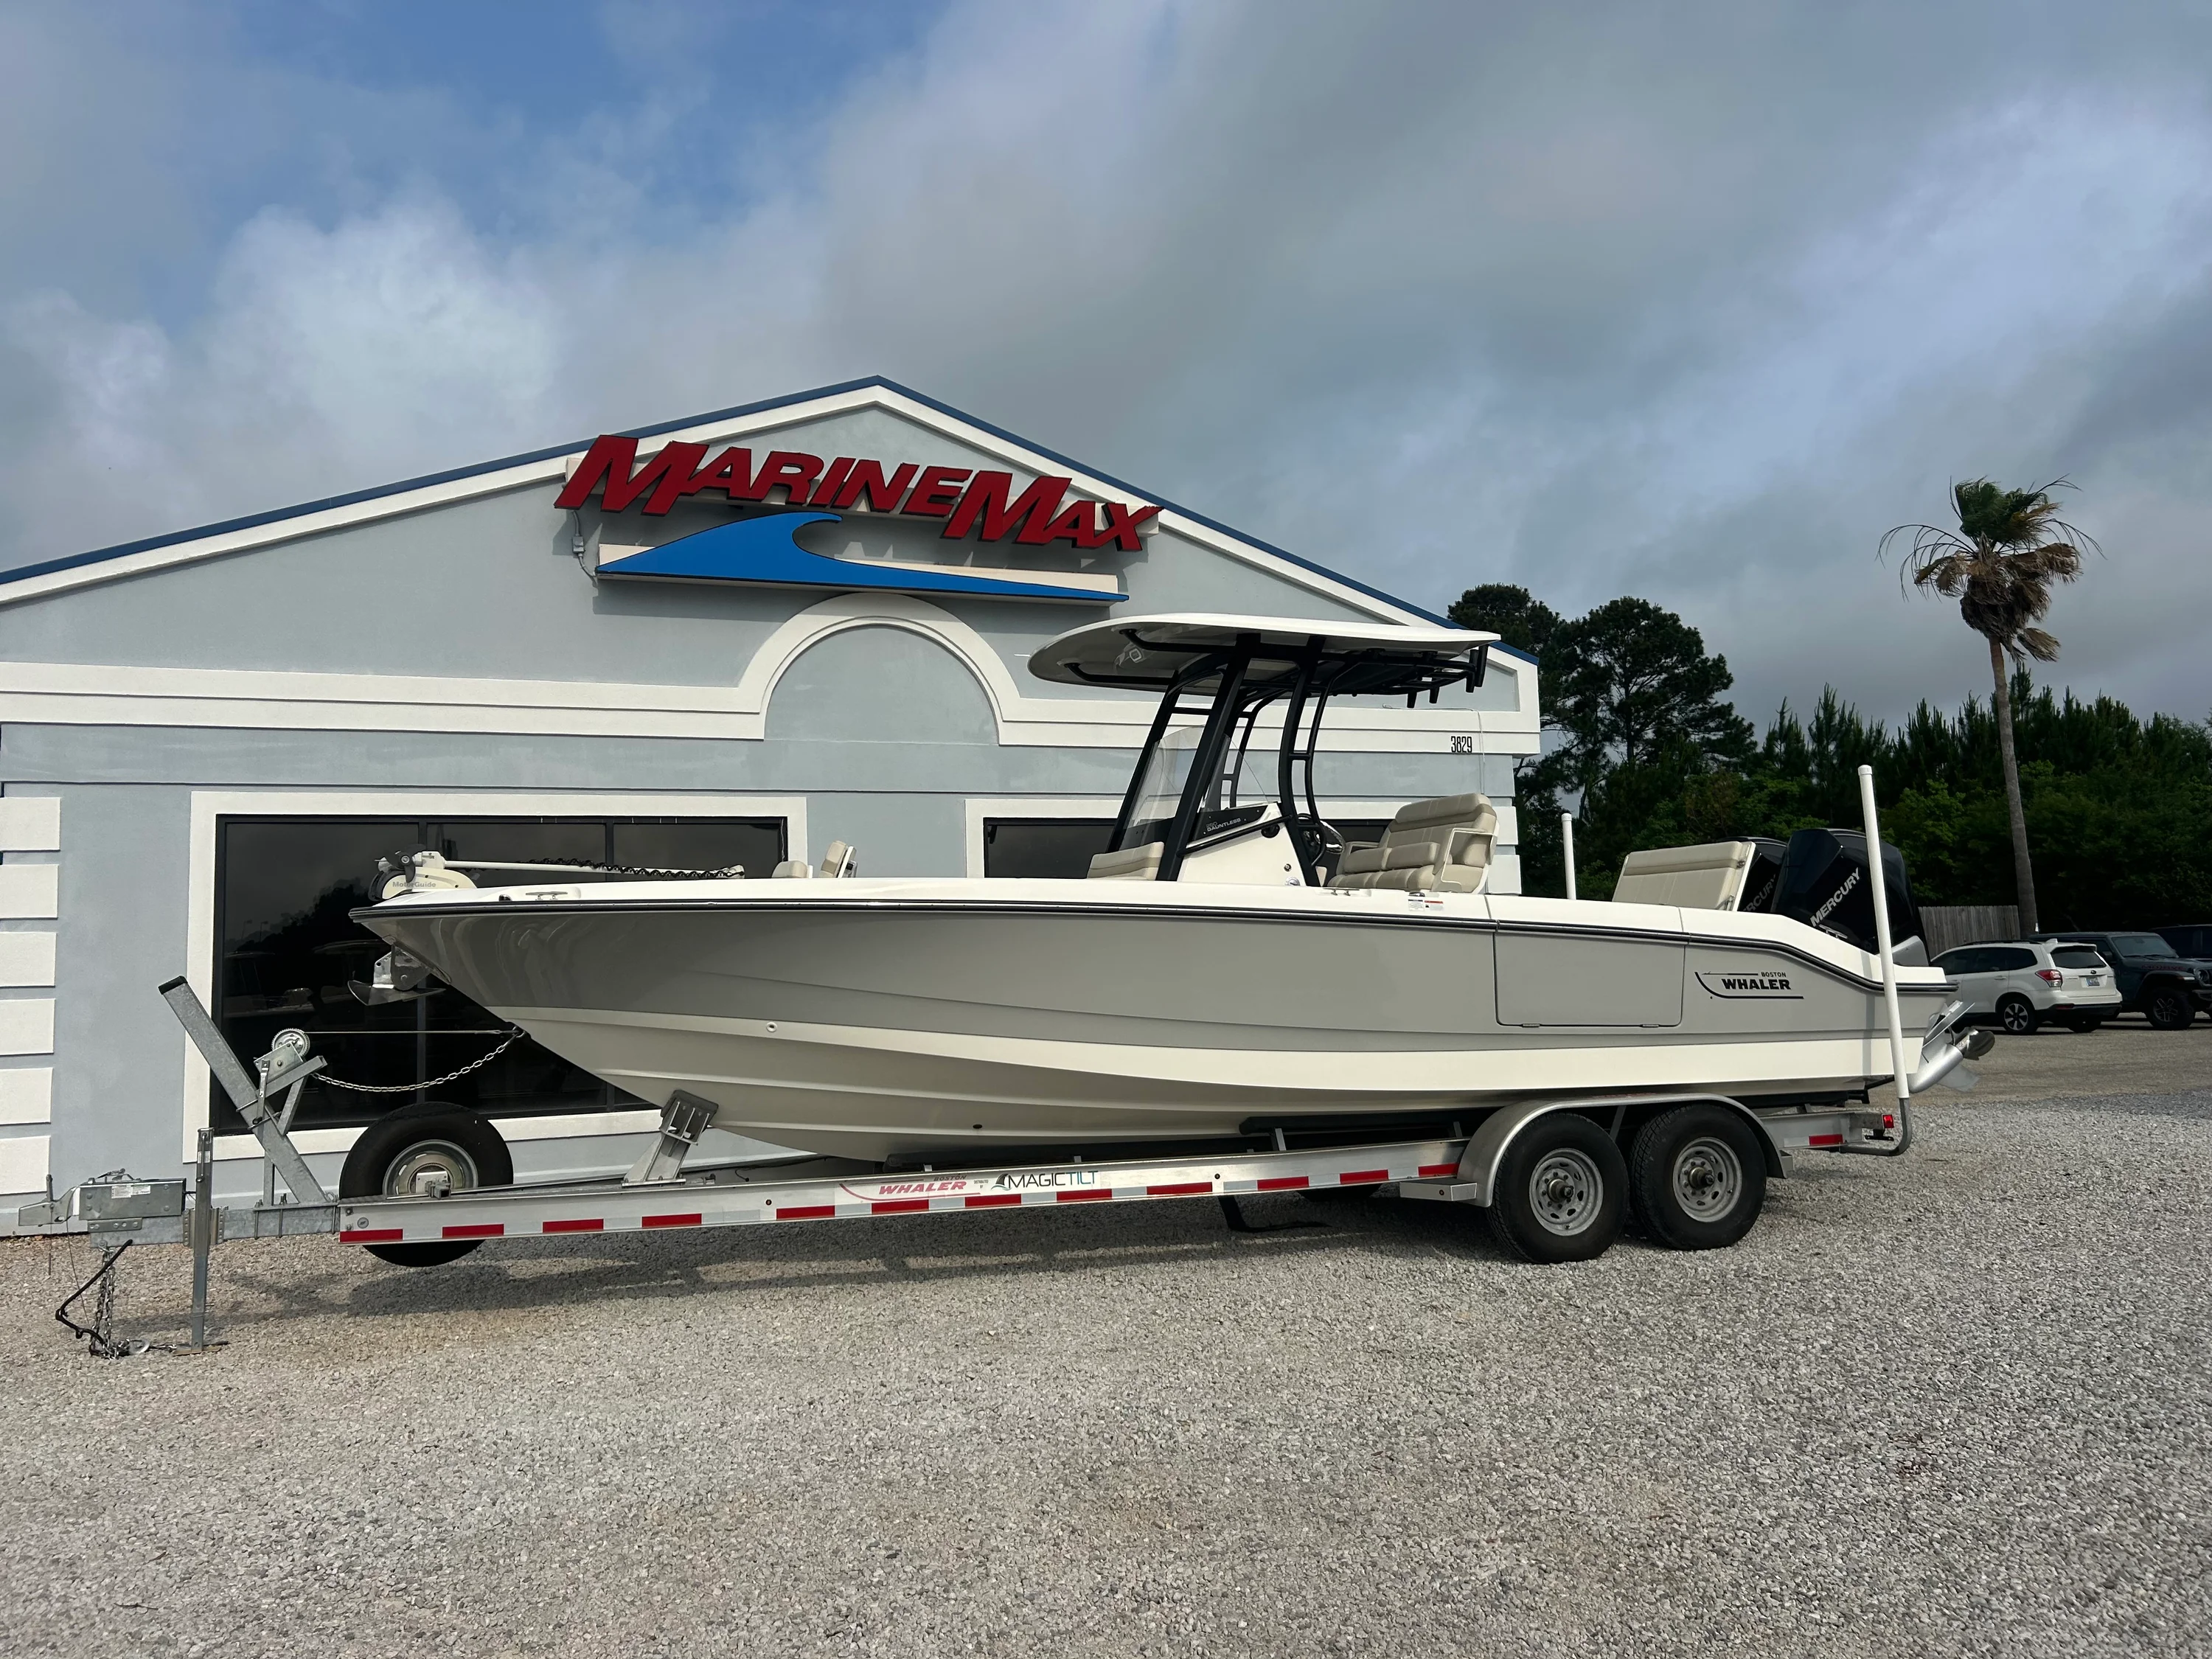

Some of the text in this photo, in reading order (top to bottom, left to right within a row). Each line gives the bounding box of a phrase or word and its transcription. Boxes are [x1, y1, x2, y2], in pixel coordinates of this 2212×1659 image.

[1450, 735, 1472, 753] 3829
[1206, 818, 1241, 832] DAUNTLESS
[1809, 867, 1861, 927] MERCURY
[1721, 978, 1791, 990] WHALER
[879, 1181, 967, 1194] WHALER
[1008, 1171, 1098, 1189] MAGICTILT
